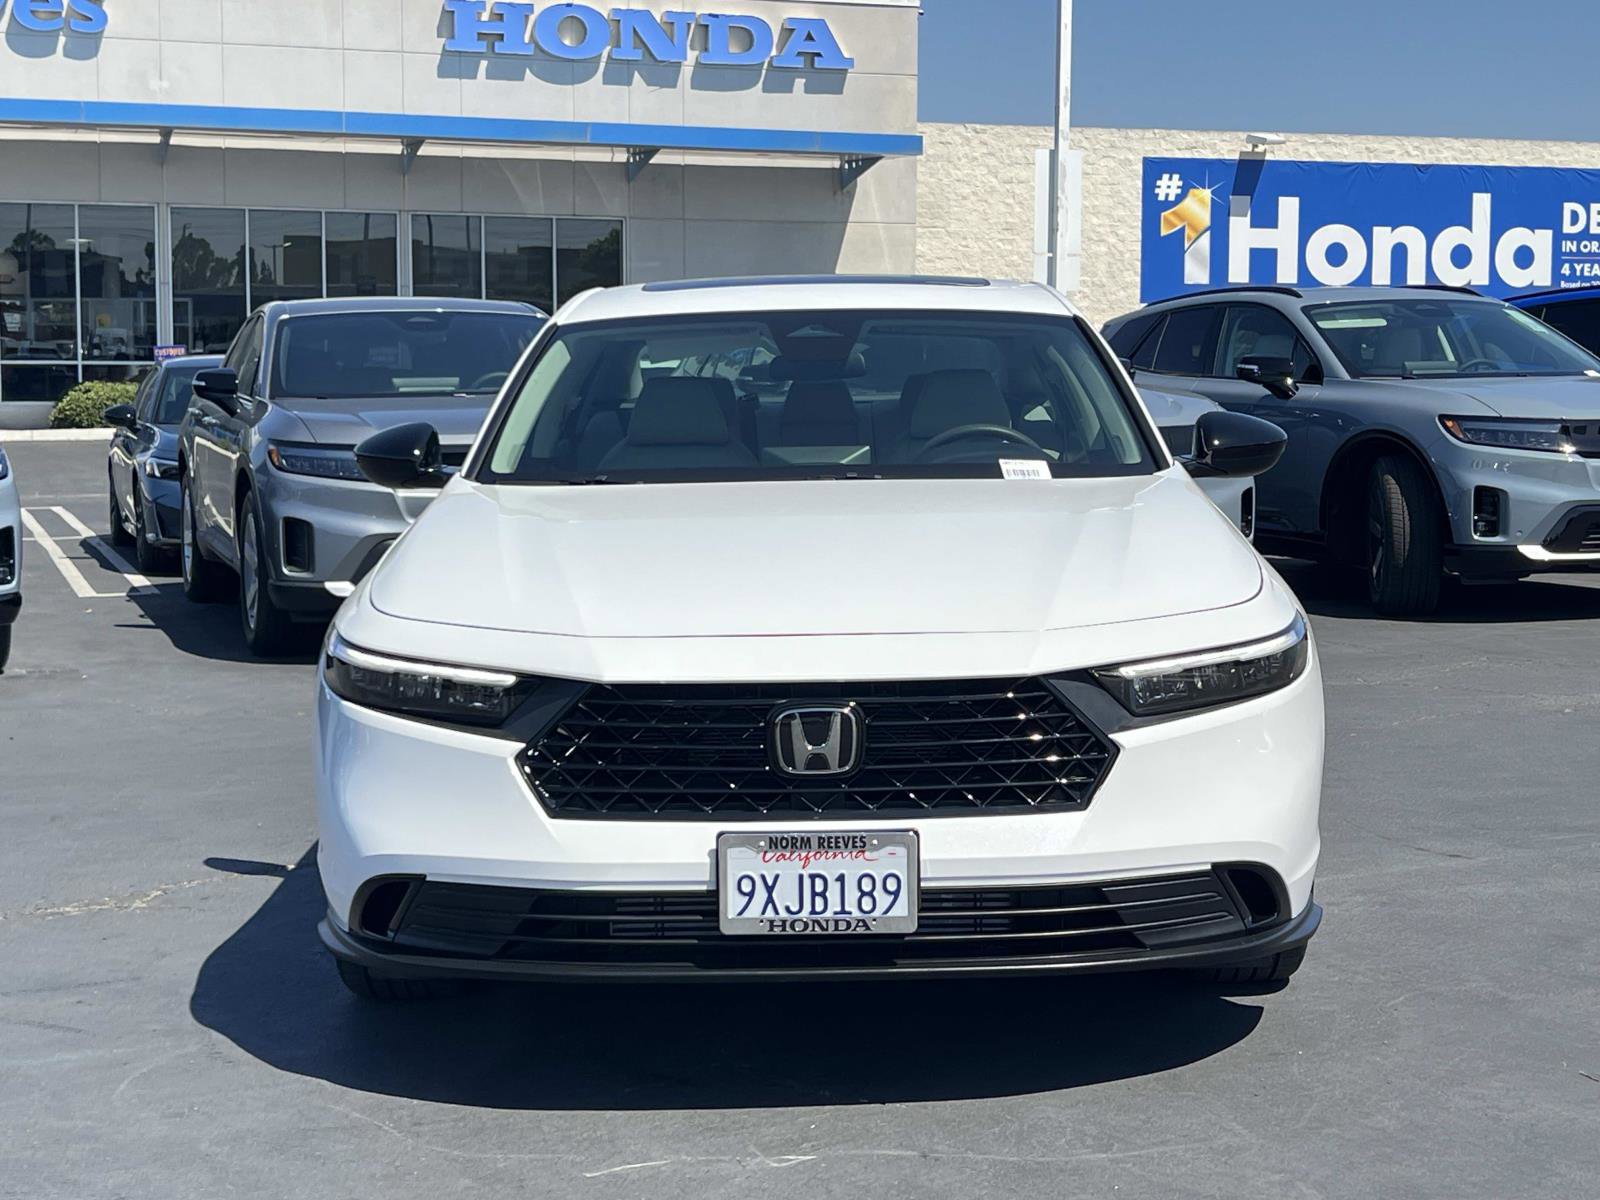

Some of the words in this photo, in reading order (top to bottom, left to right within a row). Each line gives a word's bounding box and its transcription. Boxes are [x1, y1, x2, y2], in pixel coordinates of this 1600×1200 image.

[0, 0, 108, 33] es
[444, 0, 855, 70] HONDA
[1228, 192, 1553, 287] Honda
[1561, 240, 1577, 253] IN
[1579, 240, 1600, 253] OR
[1560, 263, 1571, 276] 4
[768, 836, 812, 850] NORM
[817, 835, 867, 850] REEVES
[736, 872, 902, 916] 9XJB189
[767, 918, 873, 933] HONDA
